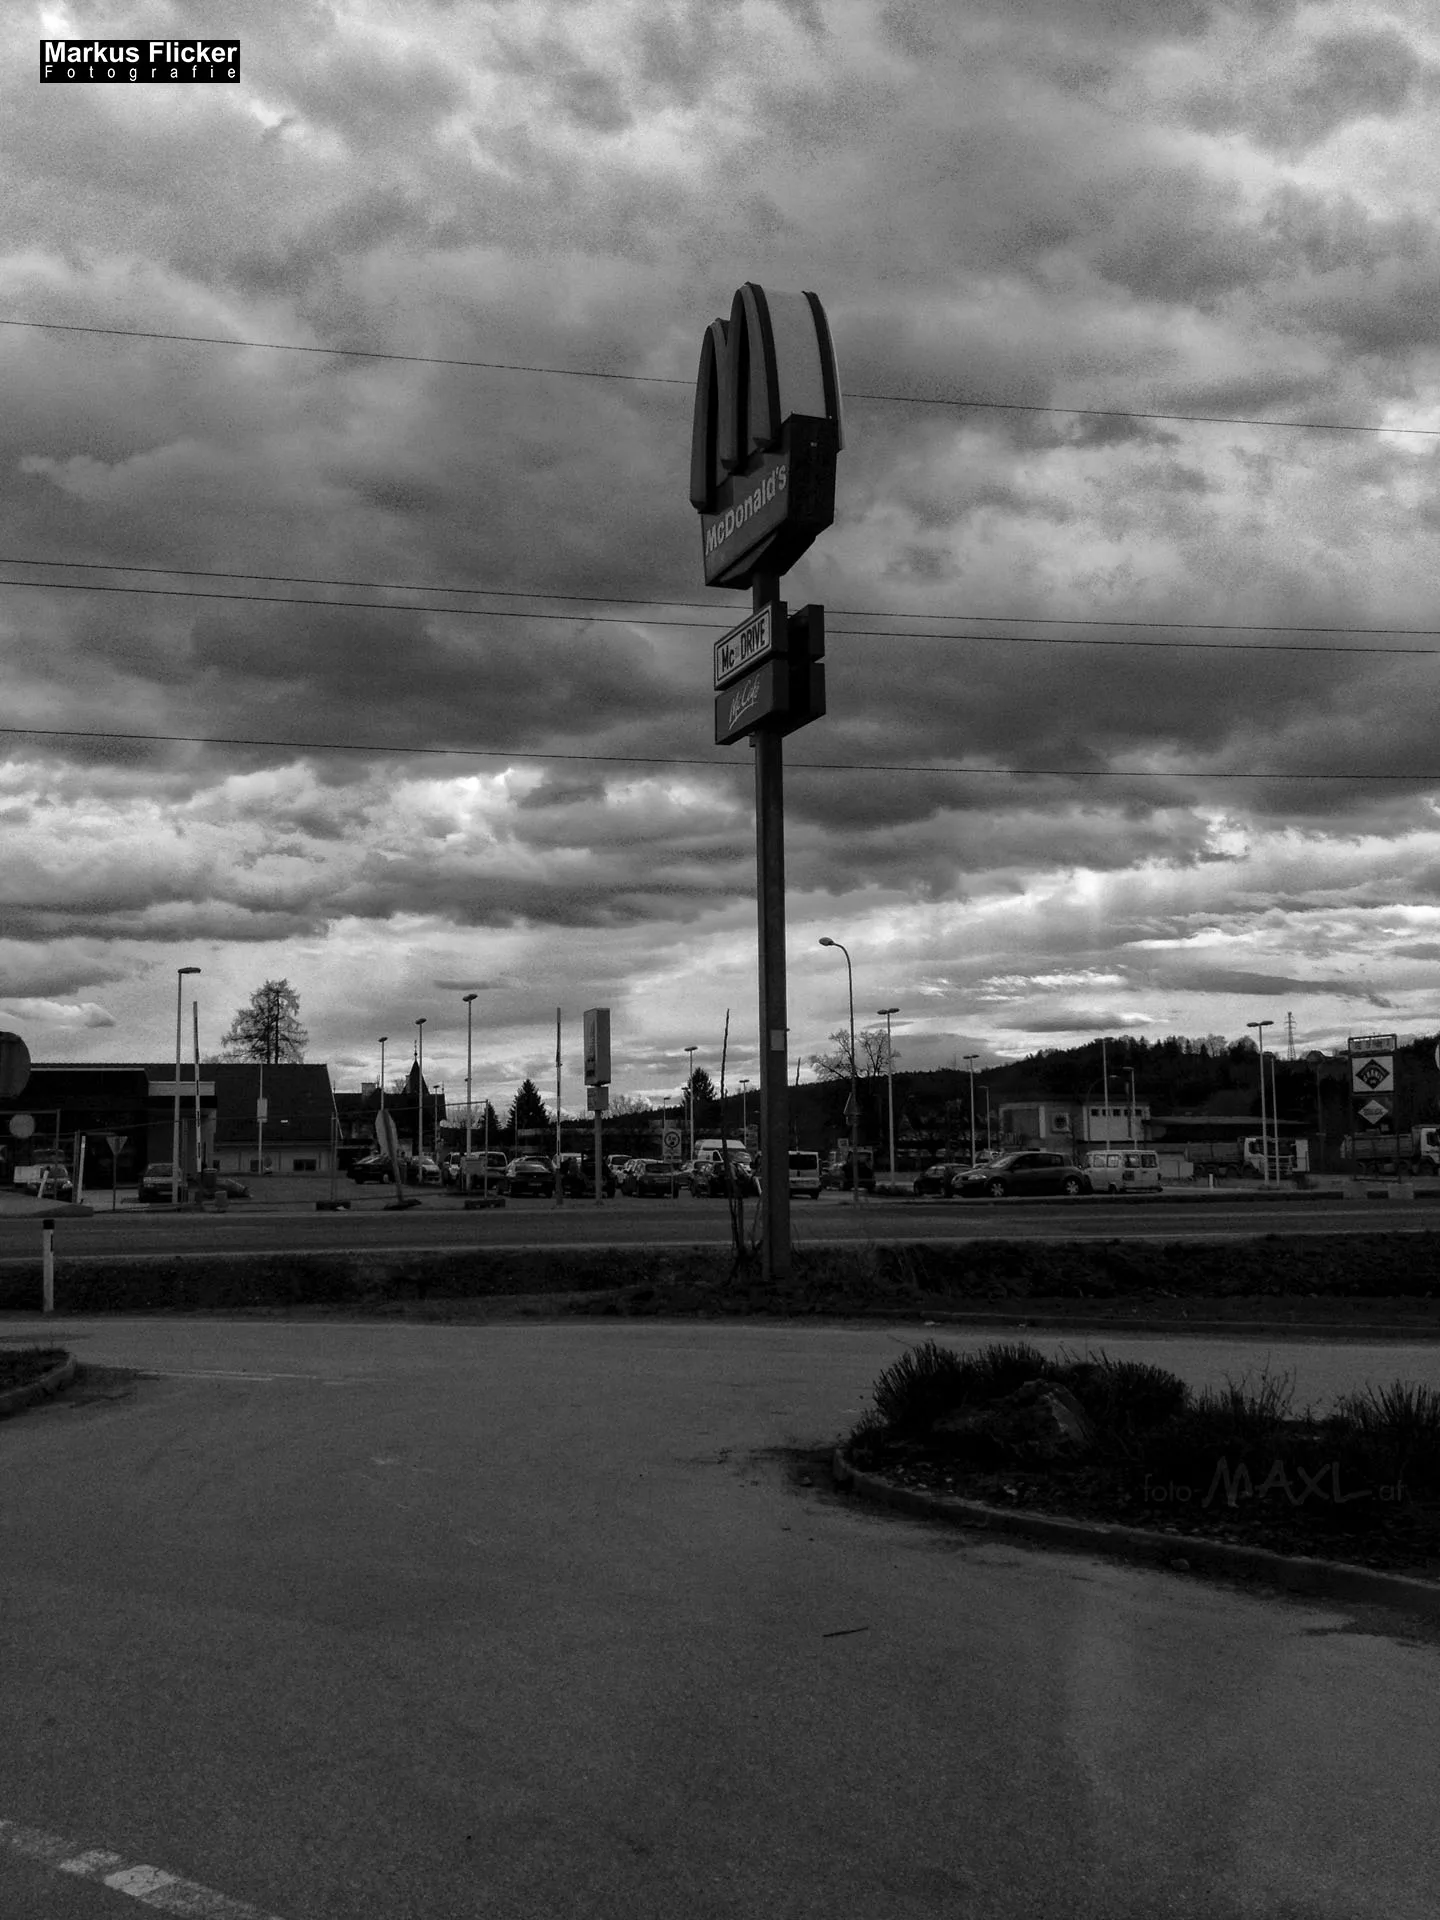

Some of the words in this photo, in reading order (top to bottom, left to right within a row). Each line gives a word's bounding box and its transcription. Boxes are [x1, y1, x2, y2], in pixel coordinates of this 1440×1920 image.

[705, 464, 787, 557] McDonald's
[721, 645, 735, 673] Mc
[740, 618, 765, 660] DRIVE
